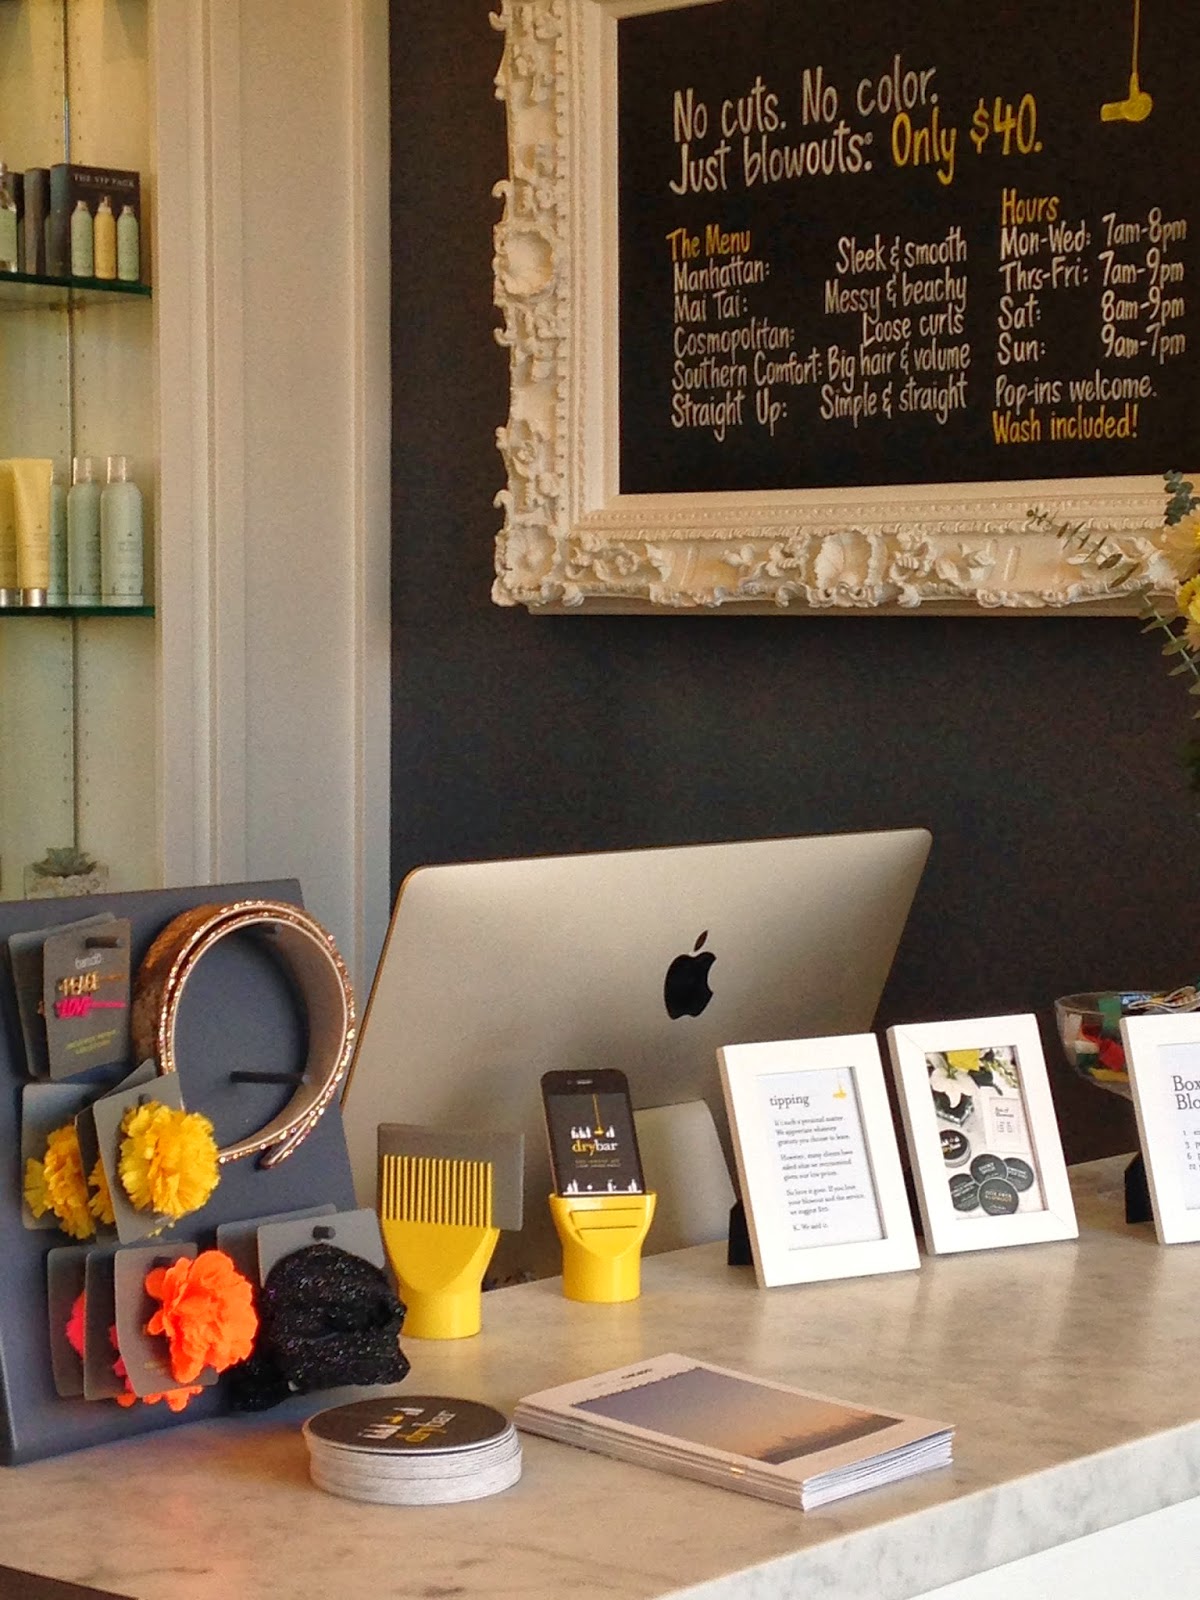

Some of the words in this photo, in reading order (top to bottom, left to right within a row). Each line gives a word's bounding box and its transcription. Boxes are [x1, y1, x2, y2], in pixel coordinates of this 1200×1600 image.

[673, 88, 707, 142] No
[721, 76, 787, 136] cuts.
[801, 66, 837, 124] No
[857, 54, 939, 114] color.
[669, 127, 731, 195] Just
[891, 109, 957, 185] Only
[970, 93, 1043, 154] $40.
[1001, 187, 1060, 226] Hours
[665, 227, 701, 262] The
[705, 223, 751, 257] Menu
[1000, 220, 1091, 261] Mon-Wed:
[1102, 206, 1187, 253] 7am-8pm
[674, 256, 770, 294] Manhattan:
[835, 233, 887, 276] Sleek
[890, 235, 901, 273] &
[904, 225, 967, 266] smooth
[998, 255, 1089, 294] Thrs-Fri:
[1098, 246, 1185, 290] 7am-9pm
[674, 293, 707, 324] Mai
[713, 289, 748, 319] Tai:
[824, 278, 880, 325] Messy
[886, 273, 897, 309] &
[902, 266, 967, 313] beachy
[997, 293, 1041, 331] Sat:
[1101, 286, 1185, 327] 8am-9pm
[674, 317, 795, 363] Cosmopolitan:
[862, 312, 911, 348] Loose
[919, 302, 964, 337] curls
[997, 332, 1046, 366] Sun:
[1100, 321, 1186, 365] 9am-7pm
[672, 356, 747, 392] Southern
[754, 347, 823, 388] Comfort:
[828, 345, 855, 394] Big
[860, 342, 893, 377] hair
[900, 343, 910, 375] &
[914, 338, 971, 371] volume
[671, 389, 745, 443] Straight
[756, 387, 787, 437] Up:
[820, 380, 878, 429] Simple
[882, 381, 892, 419] &
[899, 371, 968, 425] straight
[995, 373, 1063, 416] Pop-ins
[1069, 368, 1158, 402] welcome.
[992, 407, 1041, 445] Wash
[1051, 402, 1139, 441] included!
[769, 1095, 810, 1109] tipping
[571, 1138, 618, 1156] drybar
